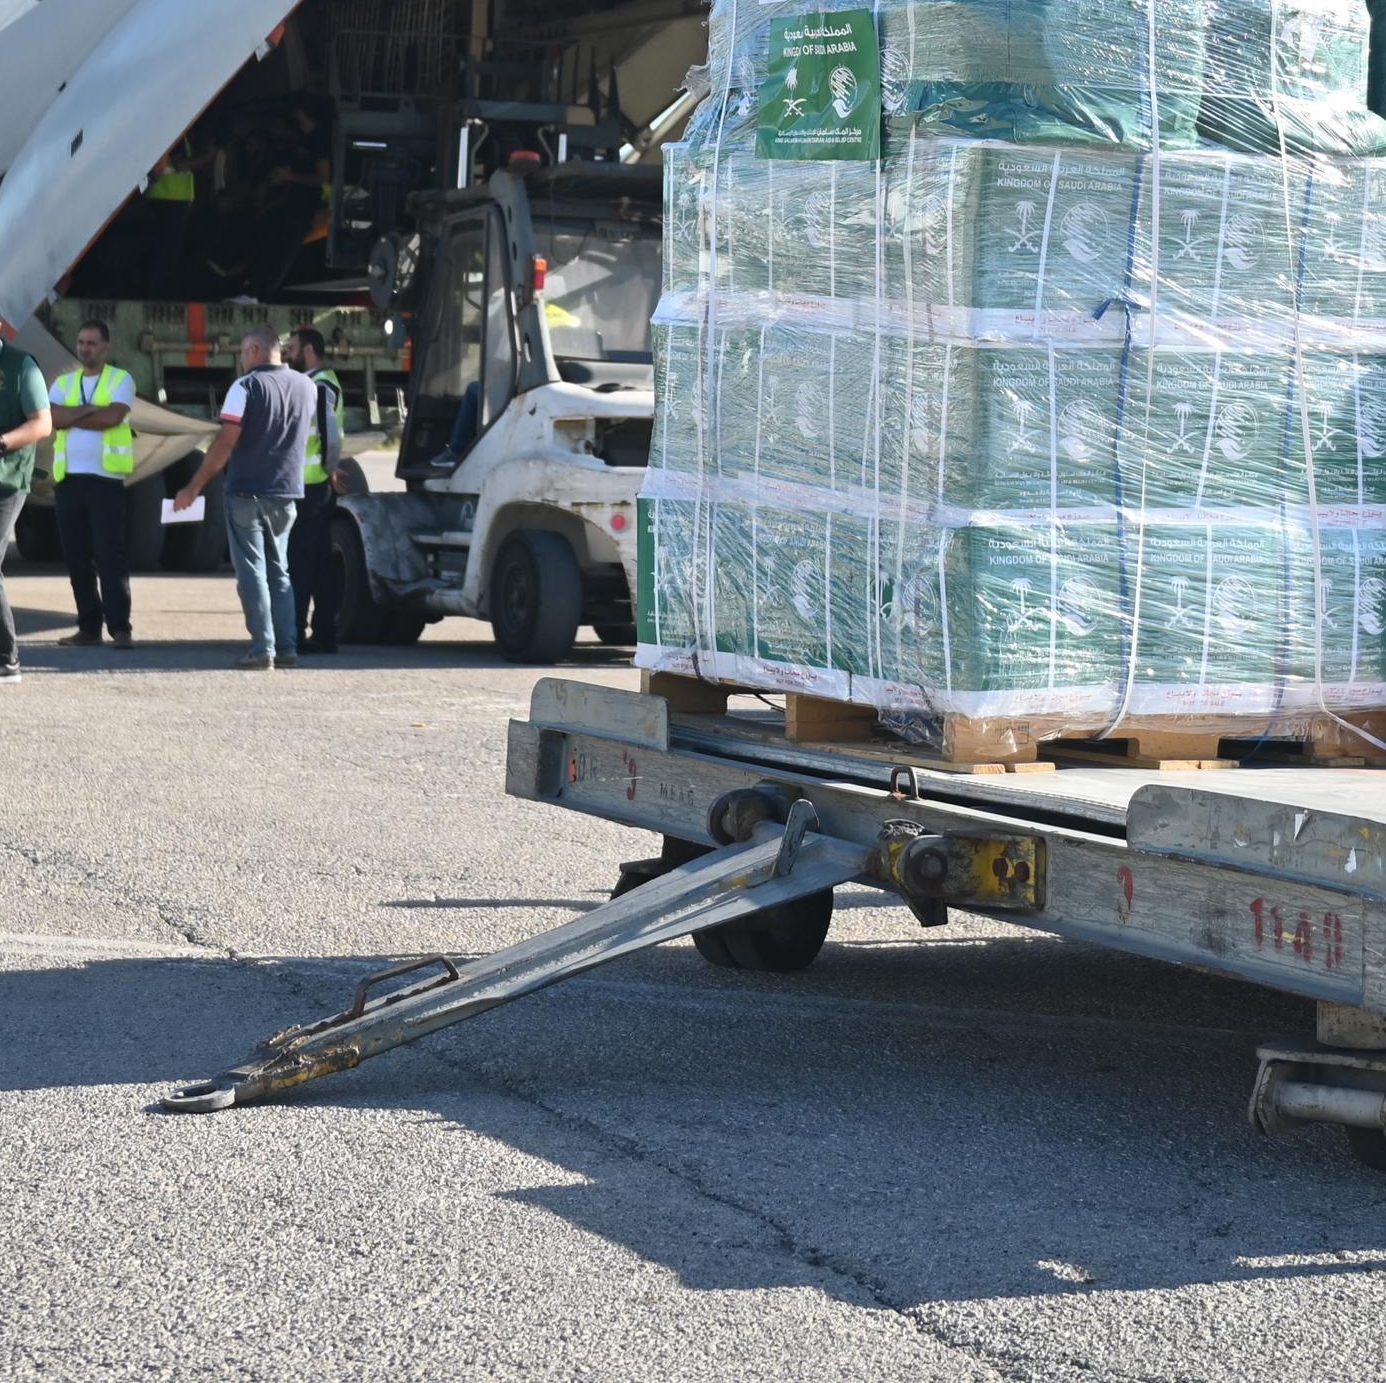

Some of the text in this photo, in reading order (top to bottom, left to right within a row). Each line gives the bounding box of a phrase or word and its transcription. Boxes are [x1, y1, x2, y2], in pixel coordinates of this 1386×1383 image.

[802, 44, 814, 55] OF
[827, 41, 857, 55] ARABIA
[998, 160, 1048, 177] السعودية
[997, 177, 1041, 188] KINGDOM
[1058, 180, 1086, 190] SAUDI
[1087, 181, 1123, 191] ARABIA
[993, 376, 1037, 387] KINGDOM
[989, 554, 1033, 565] KINGDOM
[1150, 553, 1192, 563] KINGDOM
